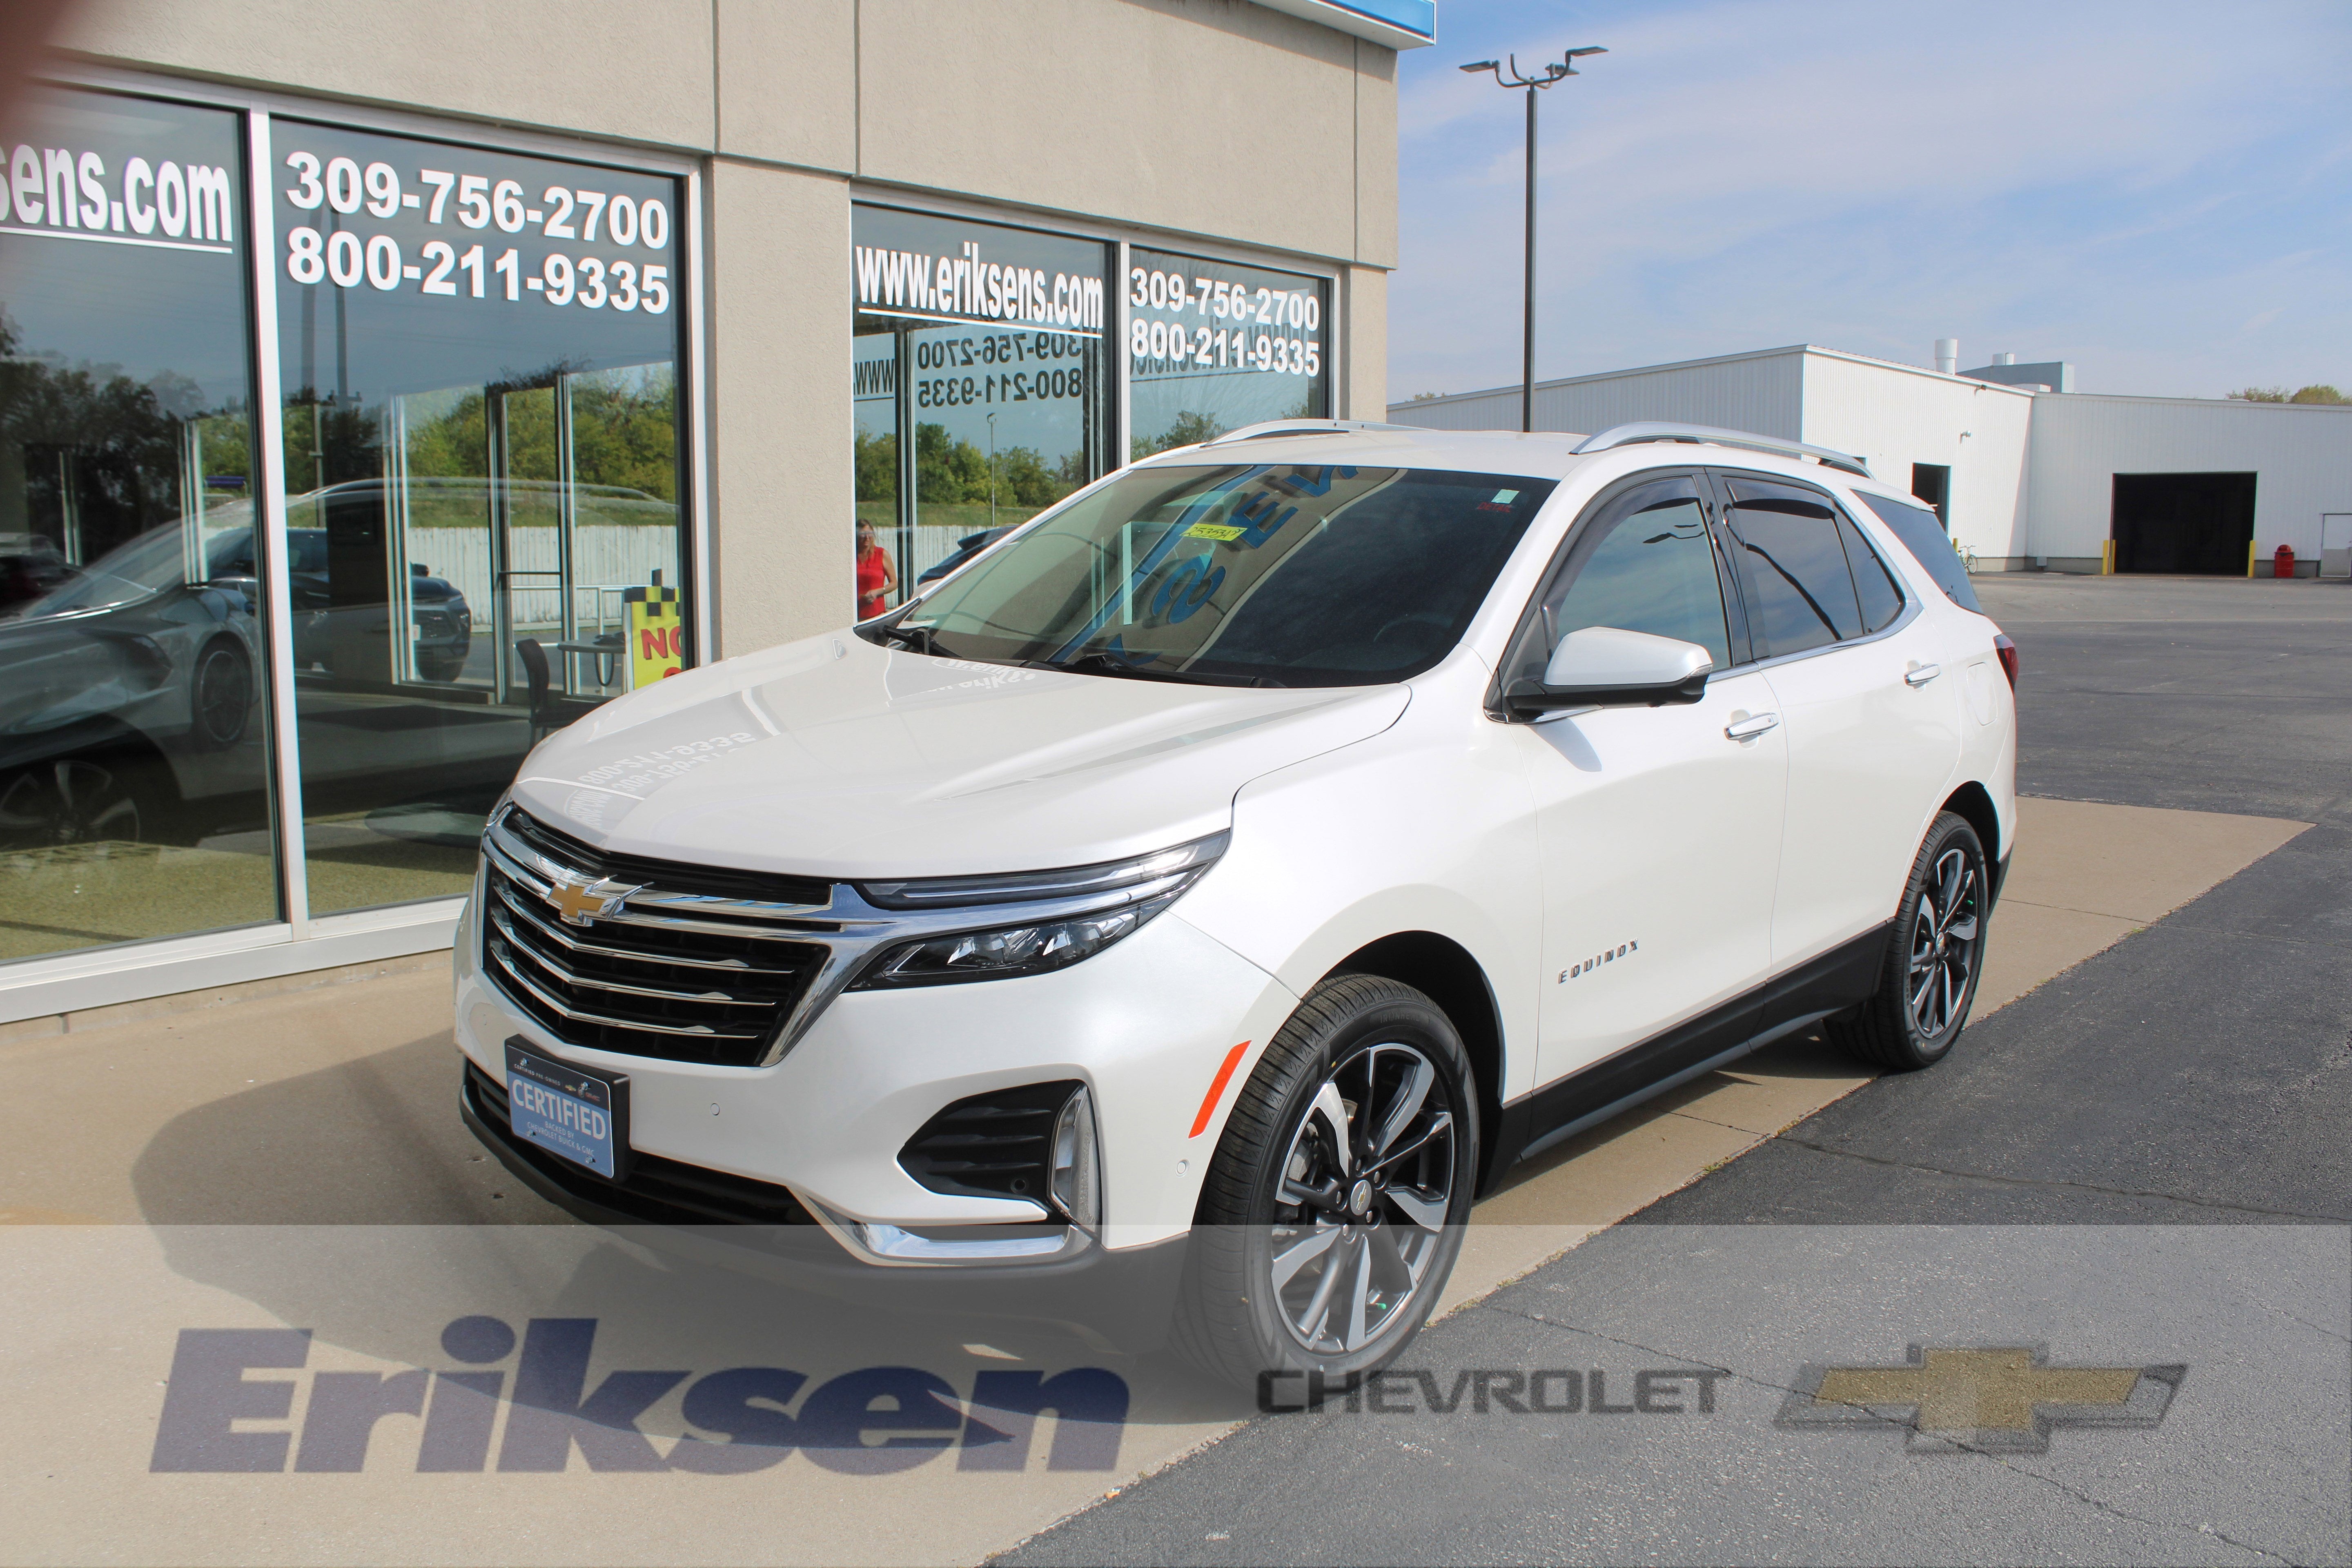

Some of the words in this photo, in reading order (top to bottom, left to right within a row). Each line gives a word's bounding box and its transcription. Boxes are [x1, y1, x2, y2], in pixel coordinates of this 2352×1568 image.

[286, 151, 669, 249] 309-756-2700
[287, 227, 670, 314] 800-211-9335
[856, 241, 1103, 330] www.eriksens.com
[1131, 267, 1319, 331] 309-756-2700
[1131, 318, 1320, 377] 800-211-9335
[1558, 937, 1638, 984] EQUINOX
[514, 1064, 535, 1076] CERTIFIED
[536, 1073, 561, 1086] PRE-OWNED
[512, 1079, 606, 1140] CERTIFIED
[527, 1122, 557, 1140] CHEVROLET
[559, 1135, 576, 1149] BUICK
[582, 1145, 595, 1157] GMC
[545, 1121, 566, 1136] BACKED
[567, 1130, 575, 1139] BY
